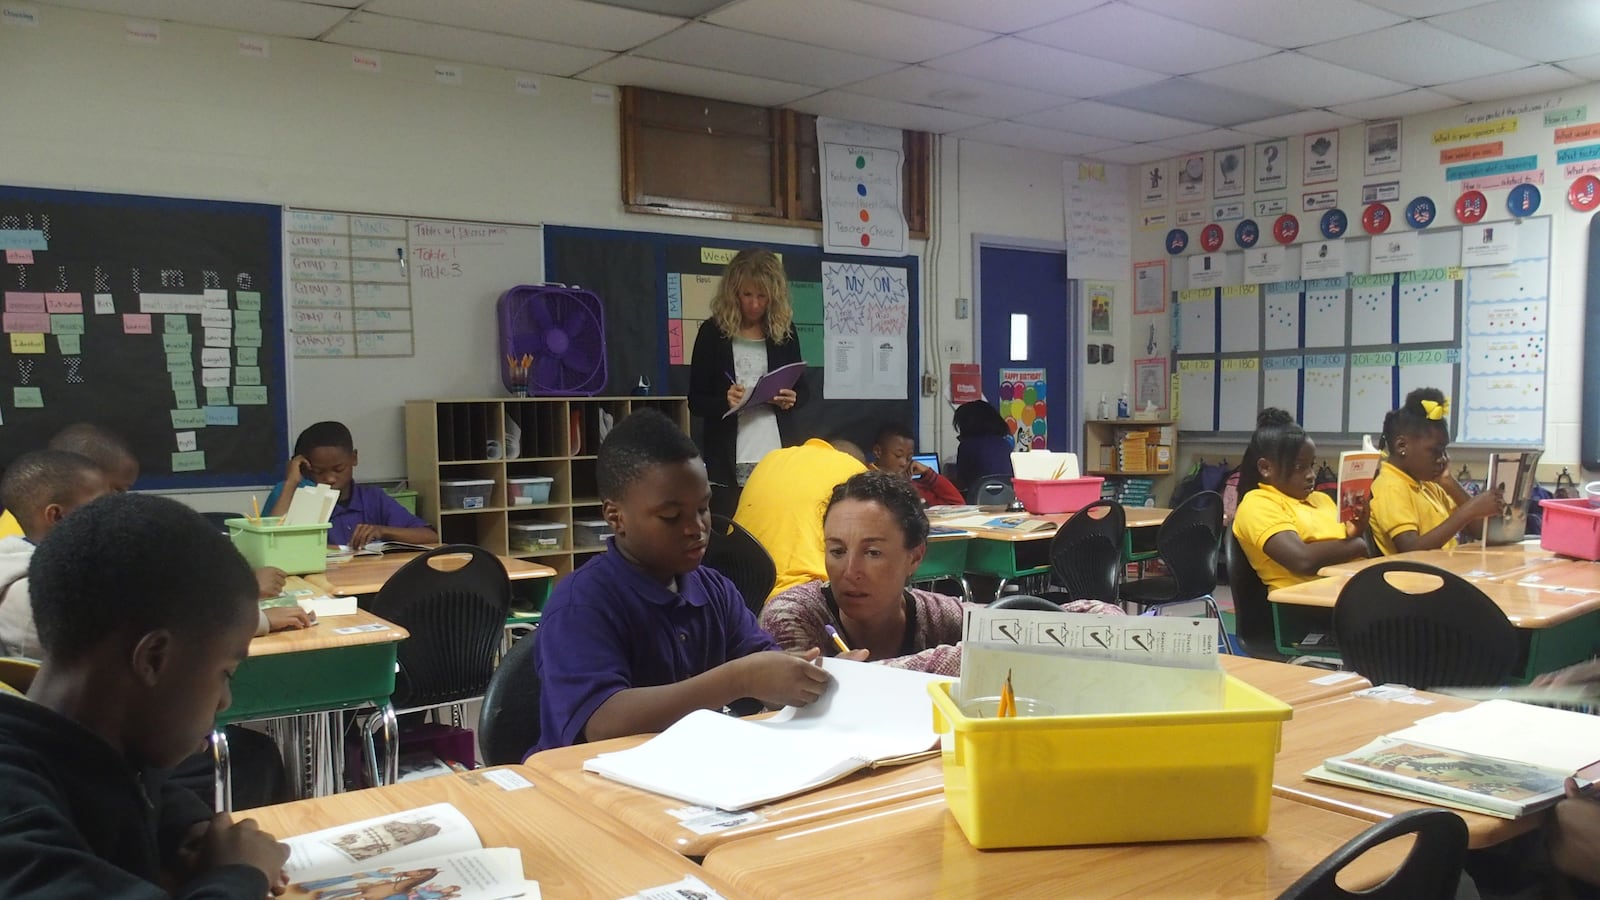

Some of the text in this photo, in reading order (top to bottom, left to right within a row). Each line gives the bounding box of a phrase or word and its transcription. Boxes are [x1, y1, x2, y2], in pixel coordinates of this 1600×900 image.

[415, 247, 449, 261] Table
[334, 261, 340, 270] 2
[416, 263, 463, 279] Table 3
[874, 276, 891, 293] ON
[668, 276, 679, 312] MATH
[334, 311, 342, 323] 4
[670, 326, 681, 358] ELA
[1004, 372, 1043, 380] HAPPY BIRTHDAY
